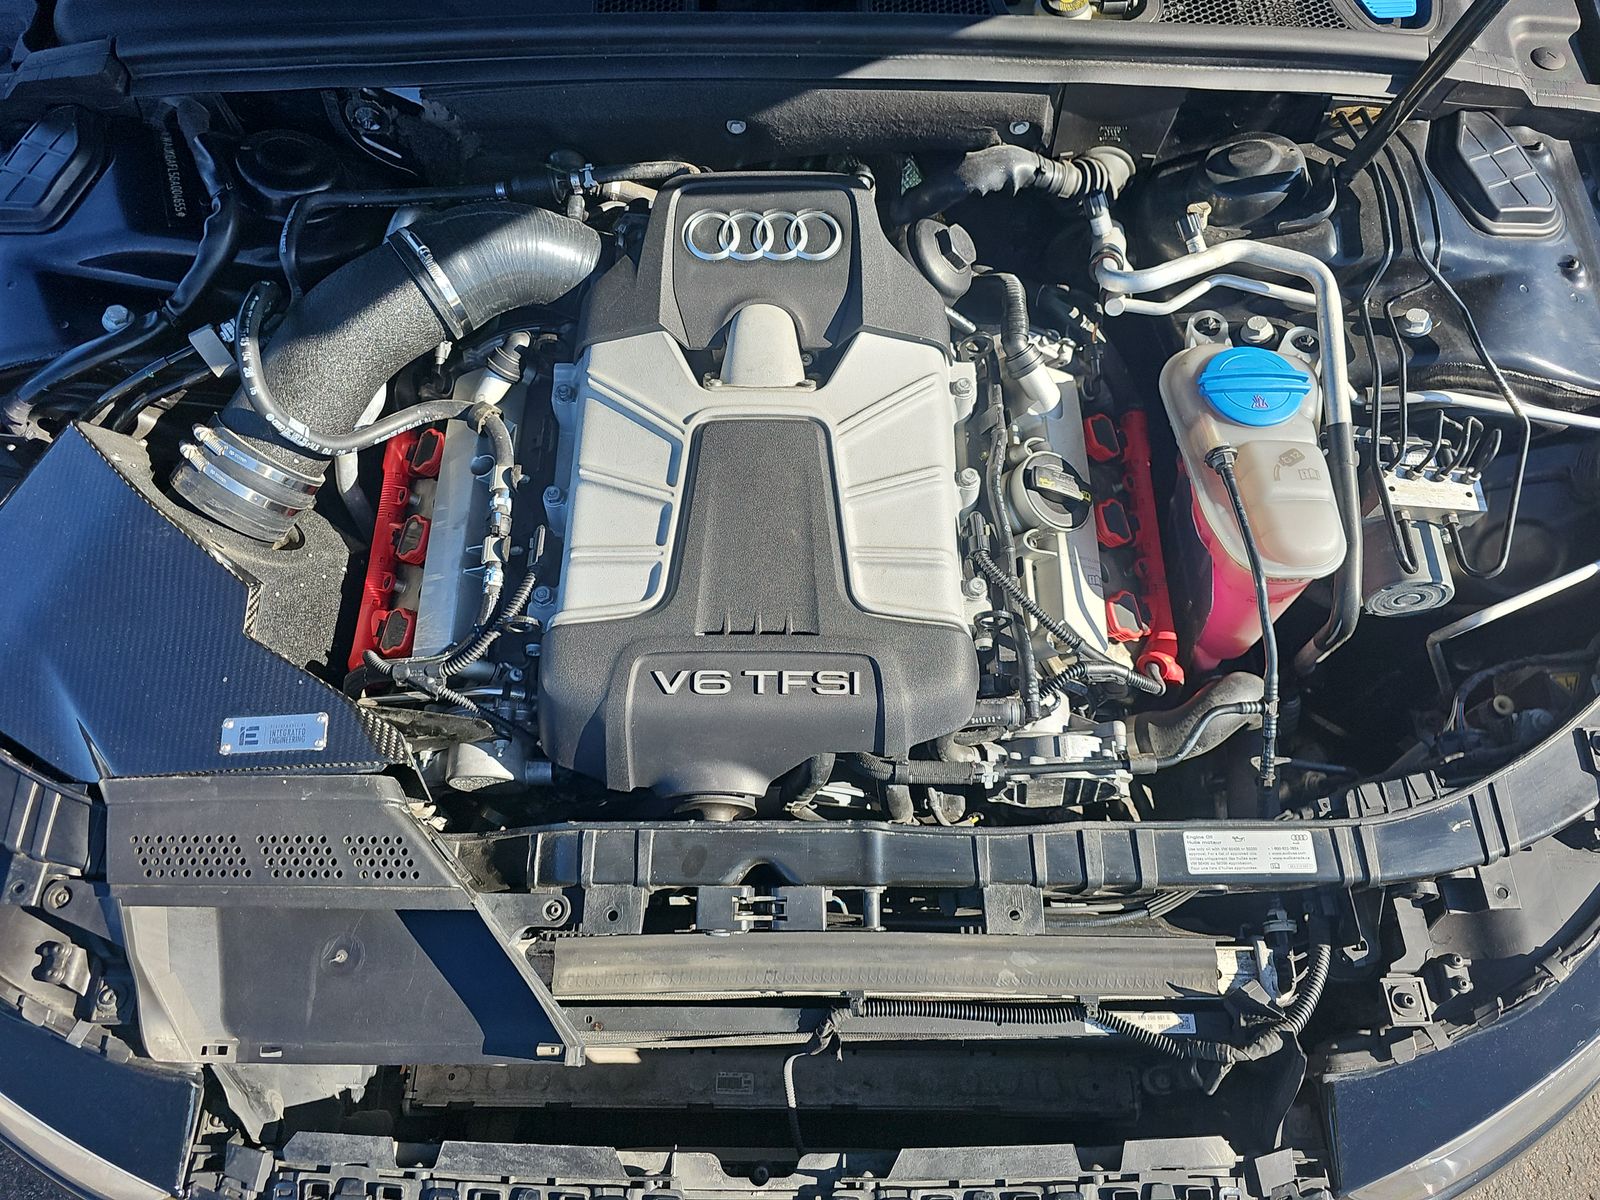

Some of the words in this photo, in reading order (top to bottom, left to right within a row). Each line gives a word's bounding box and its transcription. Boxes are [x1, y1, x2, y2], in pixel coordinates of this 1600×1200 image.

[650, 670, 732, 695] V6
[740, 670, 861, 696] TFSI
[269, 728, 306, 738] INTEGRATED
[268, 736, 306, 745] ENGINEERING
